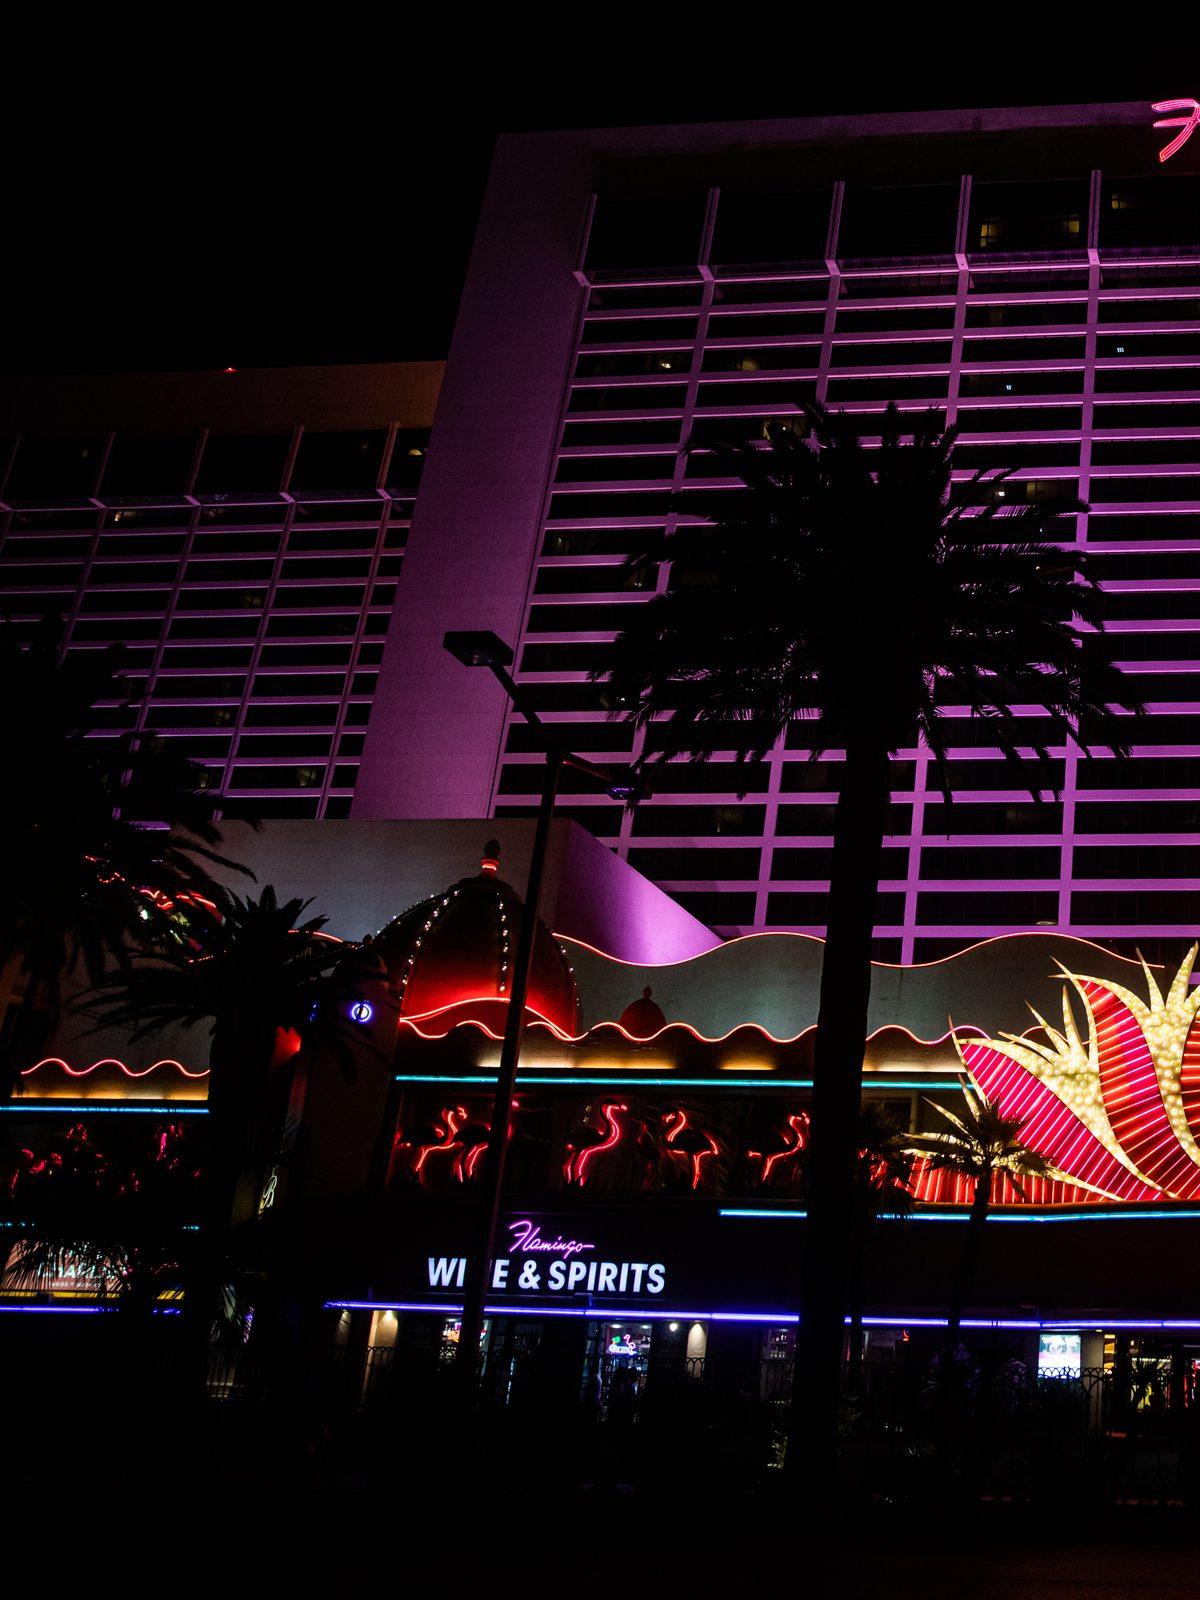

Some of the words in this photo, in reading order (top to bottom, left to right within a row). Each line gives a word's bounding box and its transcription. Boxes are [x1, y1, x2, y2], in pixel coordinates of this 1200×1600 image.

[508, 1220, 595, 1259] Flamingo
[427, 1257, 510, 1289] WIE
[517, 1259, 542, 1291] &
[547, 1260, 666, 1294] SPIRITS
